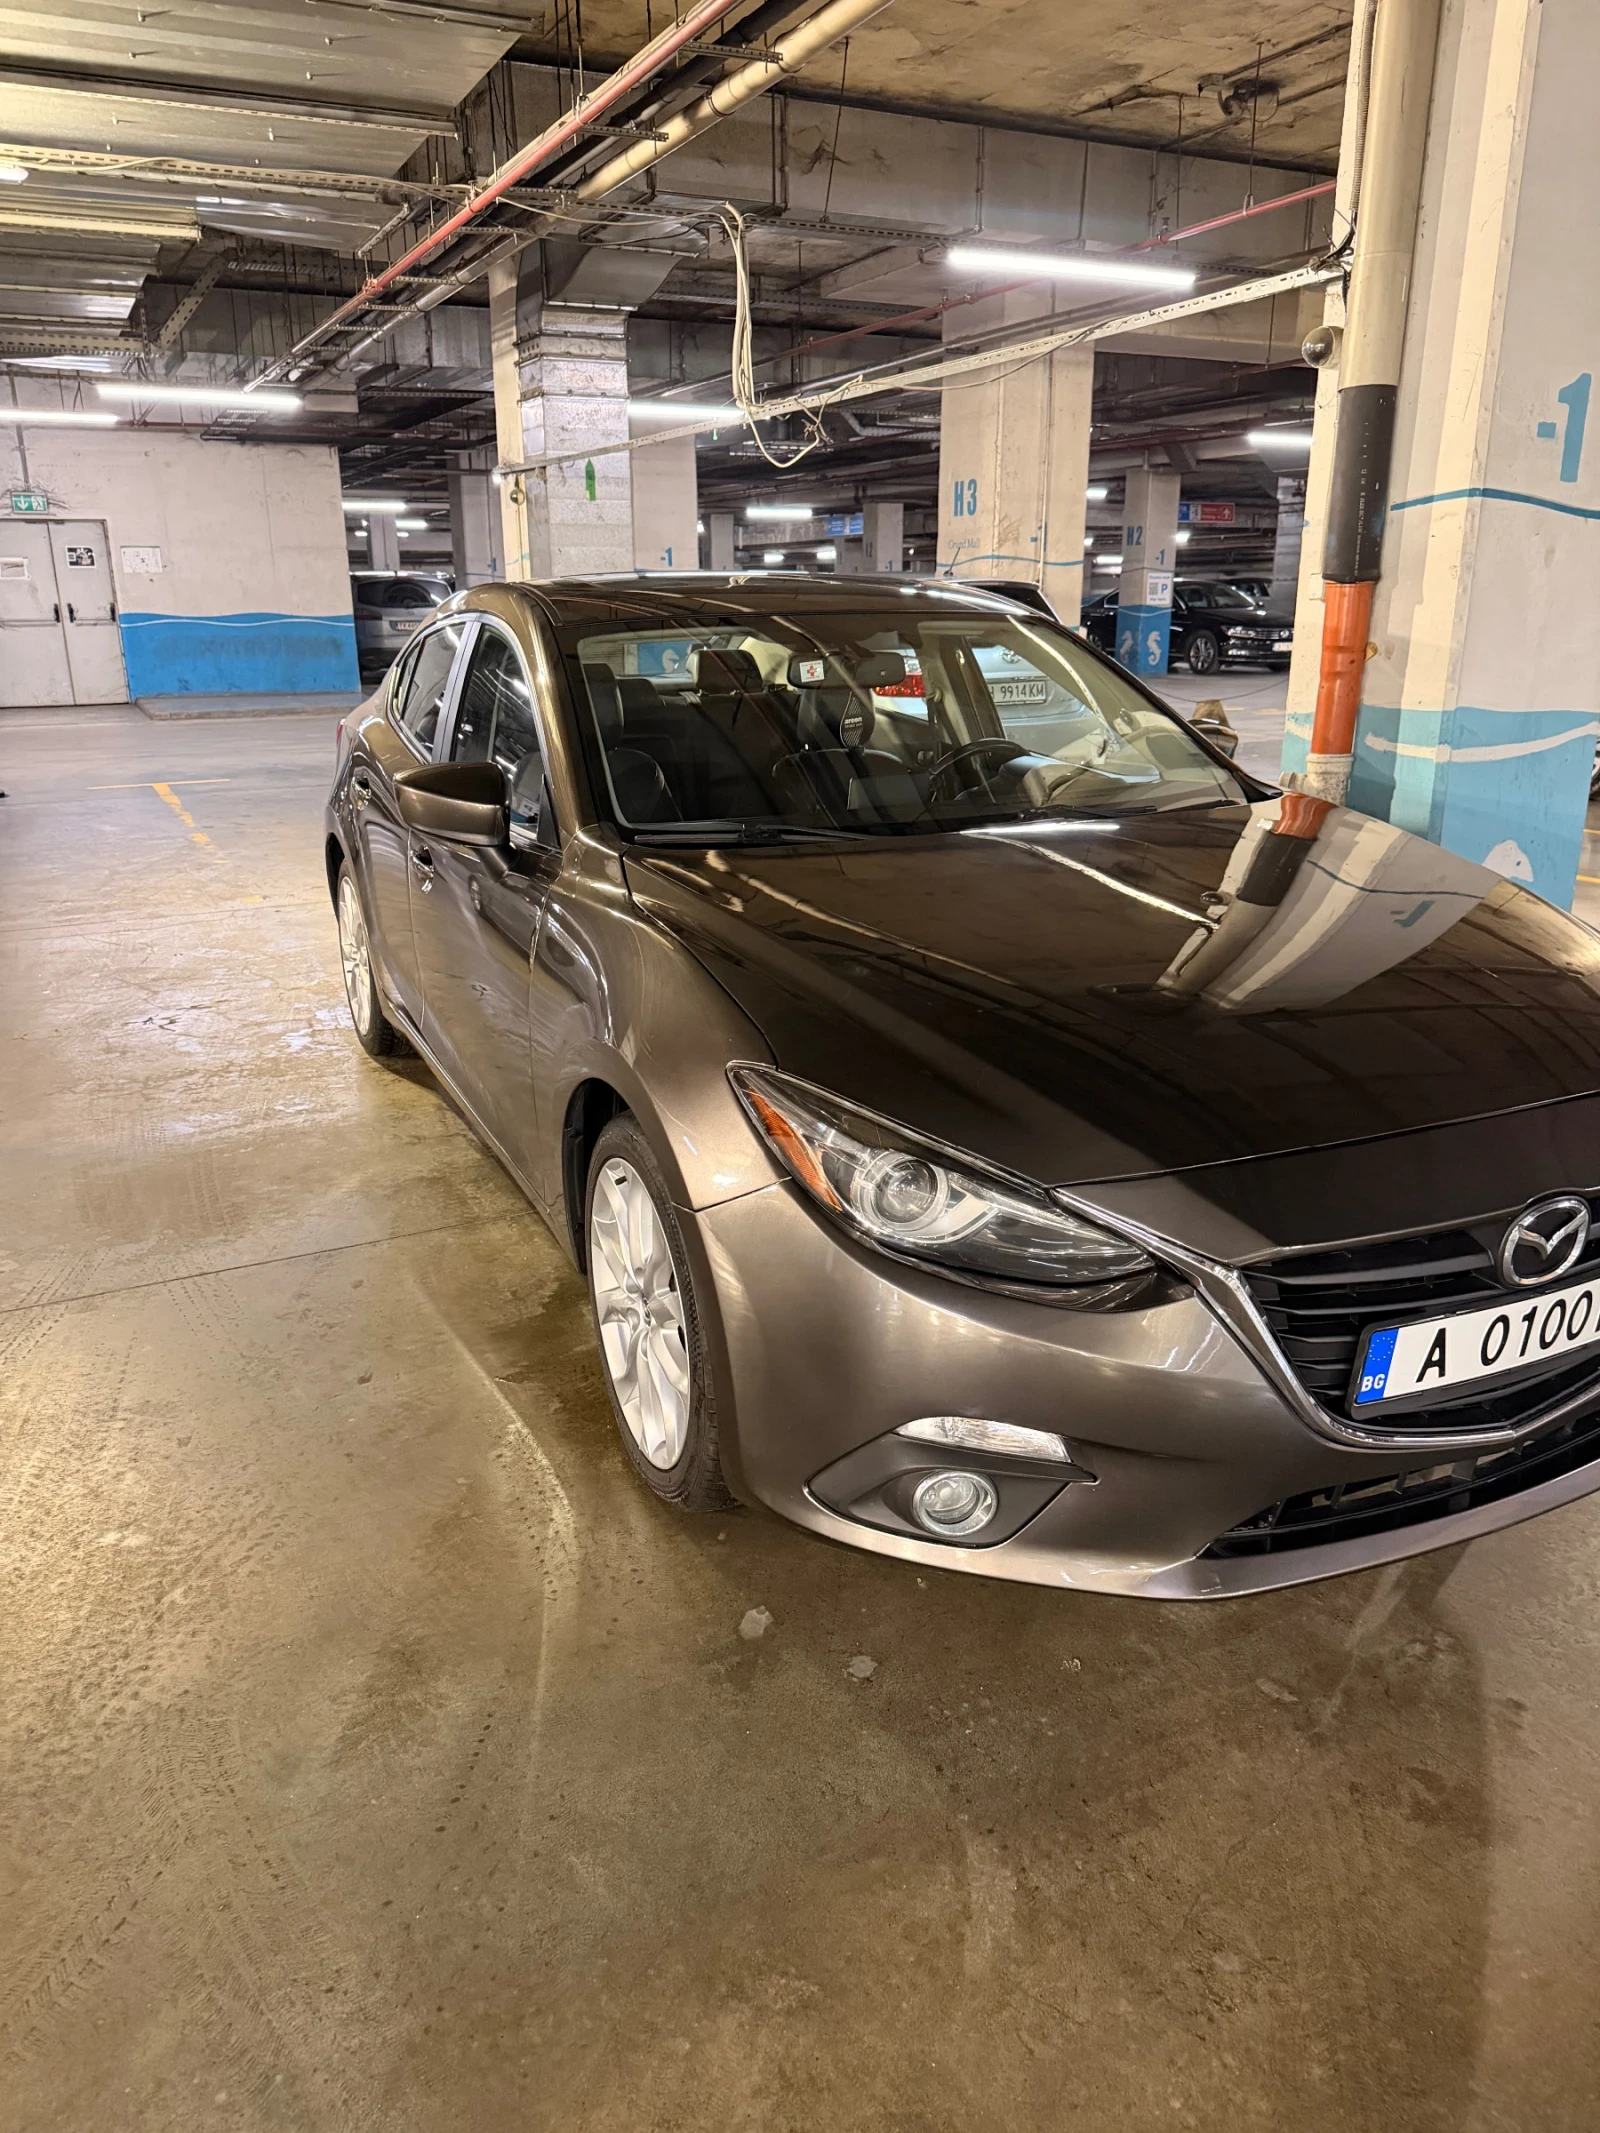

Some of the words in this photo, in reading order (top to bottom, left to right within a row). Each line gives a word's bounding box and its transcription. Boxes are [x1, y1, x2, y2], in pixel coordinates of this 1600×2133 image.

[1536, 372, 1592, 483] -1
[660, 547, 673, 567] -1
[1155, 549, 1165, 565] -1
[1161, 584, 1168, 595] P
[1415, 1327, 1446, 1384] A
[1480, 1290, 1600, 1367] 0100
[1360, 1373, 1385, 1393] BG
